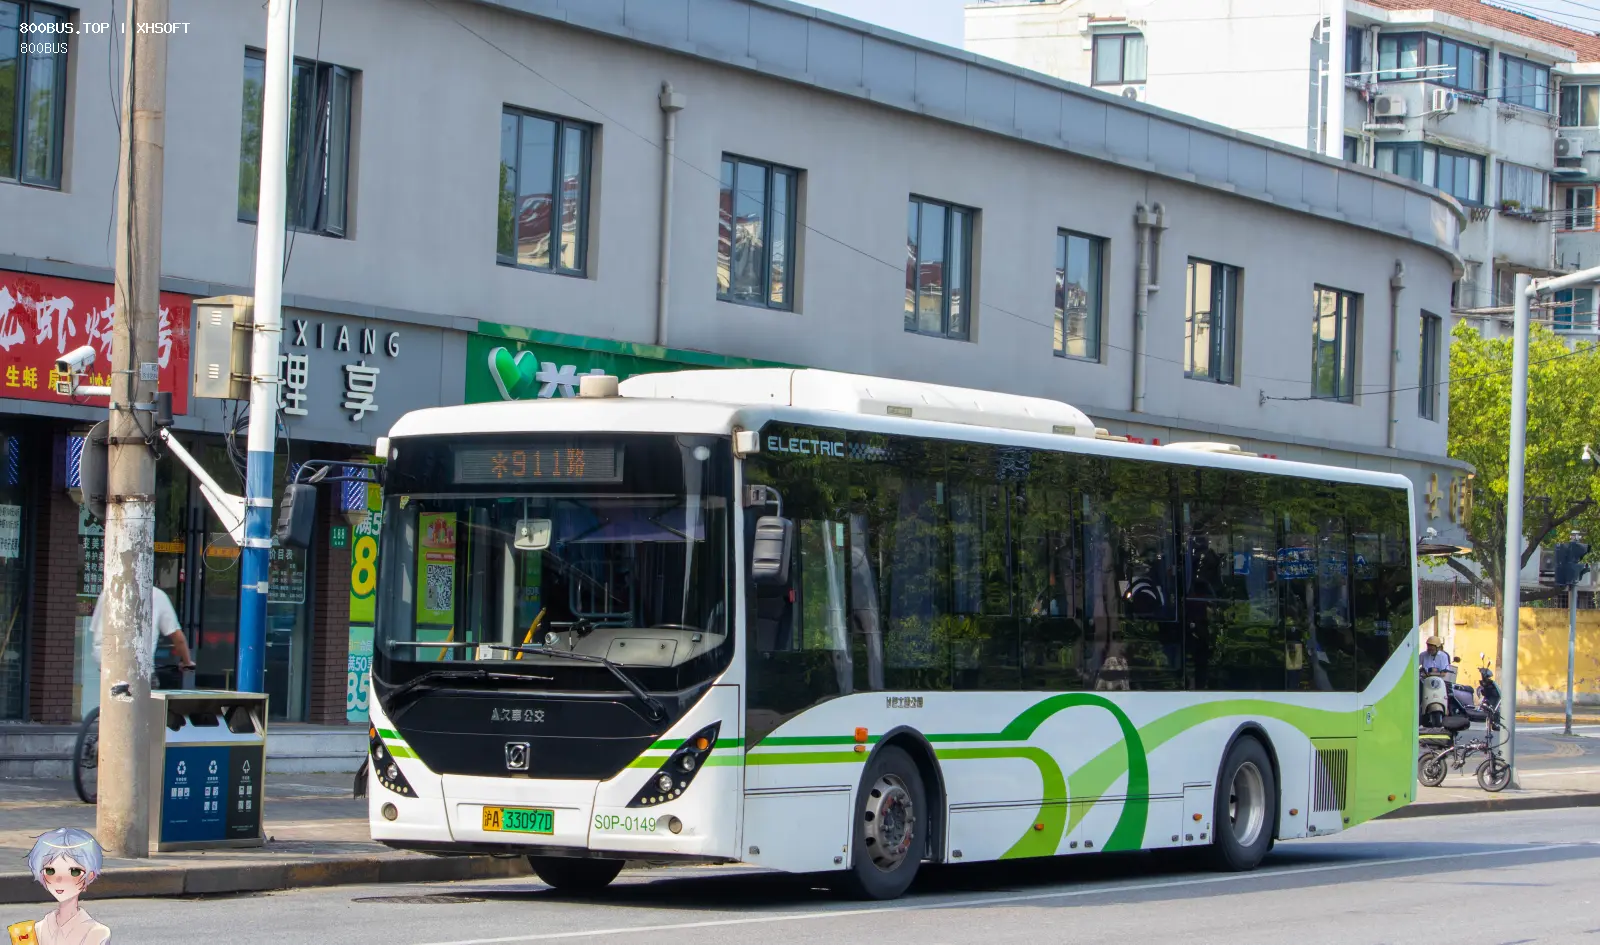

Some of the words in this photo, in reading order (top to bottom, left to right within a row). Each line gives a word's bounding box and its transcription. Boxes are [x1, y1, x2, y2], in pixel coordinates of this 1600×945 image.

[293, 319, 400, 358] XIANG
[6, 365, 37, 389] 生蚝
[276, 352, 381, 422] 理享
[767, 435, 845, 457] ELECTRIC
